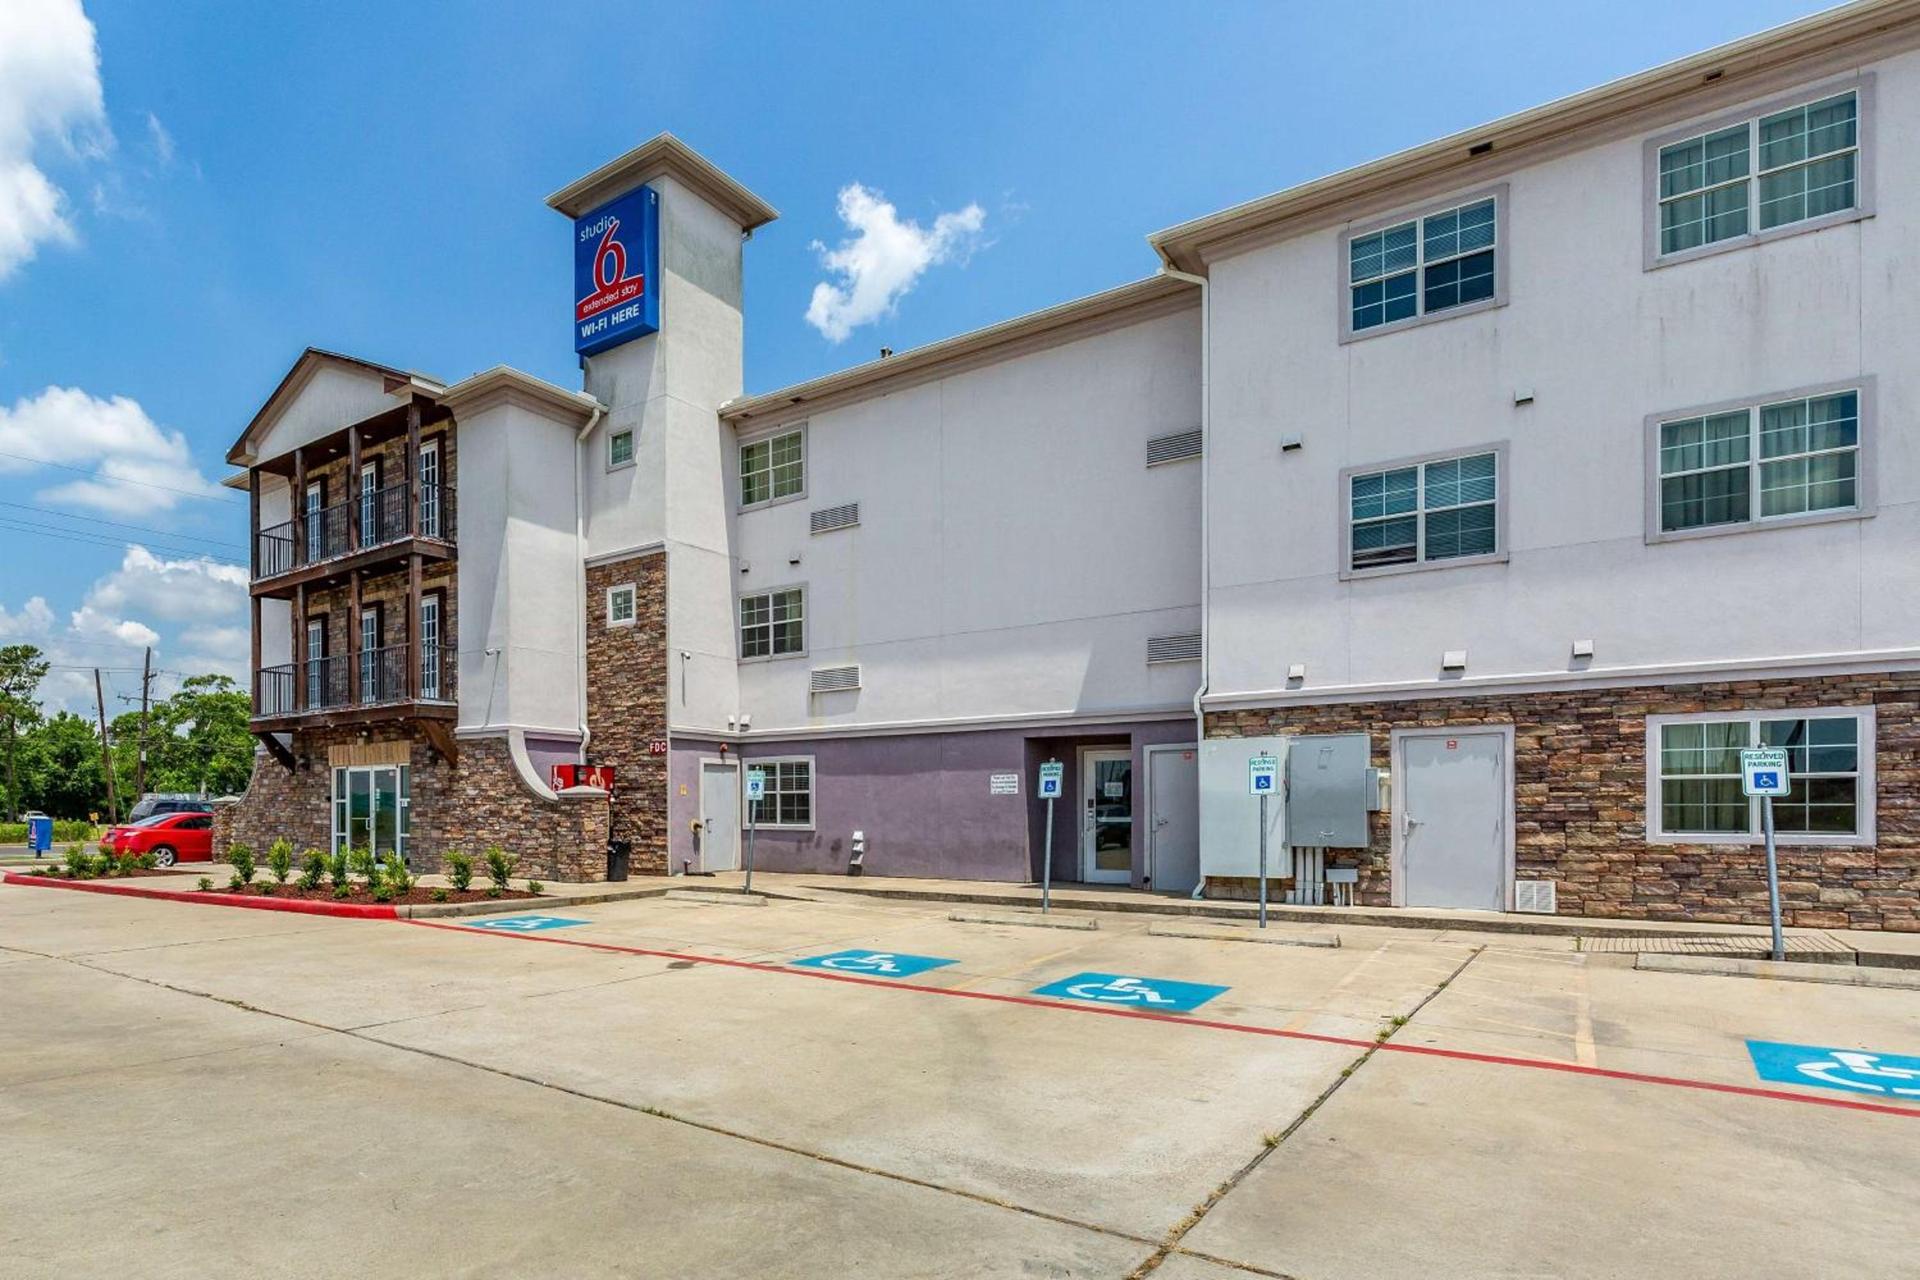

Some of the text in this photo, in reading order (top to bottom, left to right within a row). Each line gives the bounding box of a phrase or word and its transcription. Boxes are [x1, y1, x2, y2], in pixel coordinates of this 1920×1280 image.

[580, 215, 616, 242] studio
[593, 220, 627, 292] 6
[583, 282, 639, 313] extended stay
[582, 303, 640, 338] WI-FI HERE
[650, 741, 667, 753] FDC
